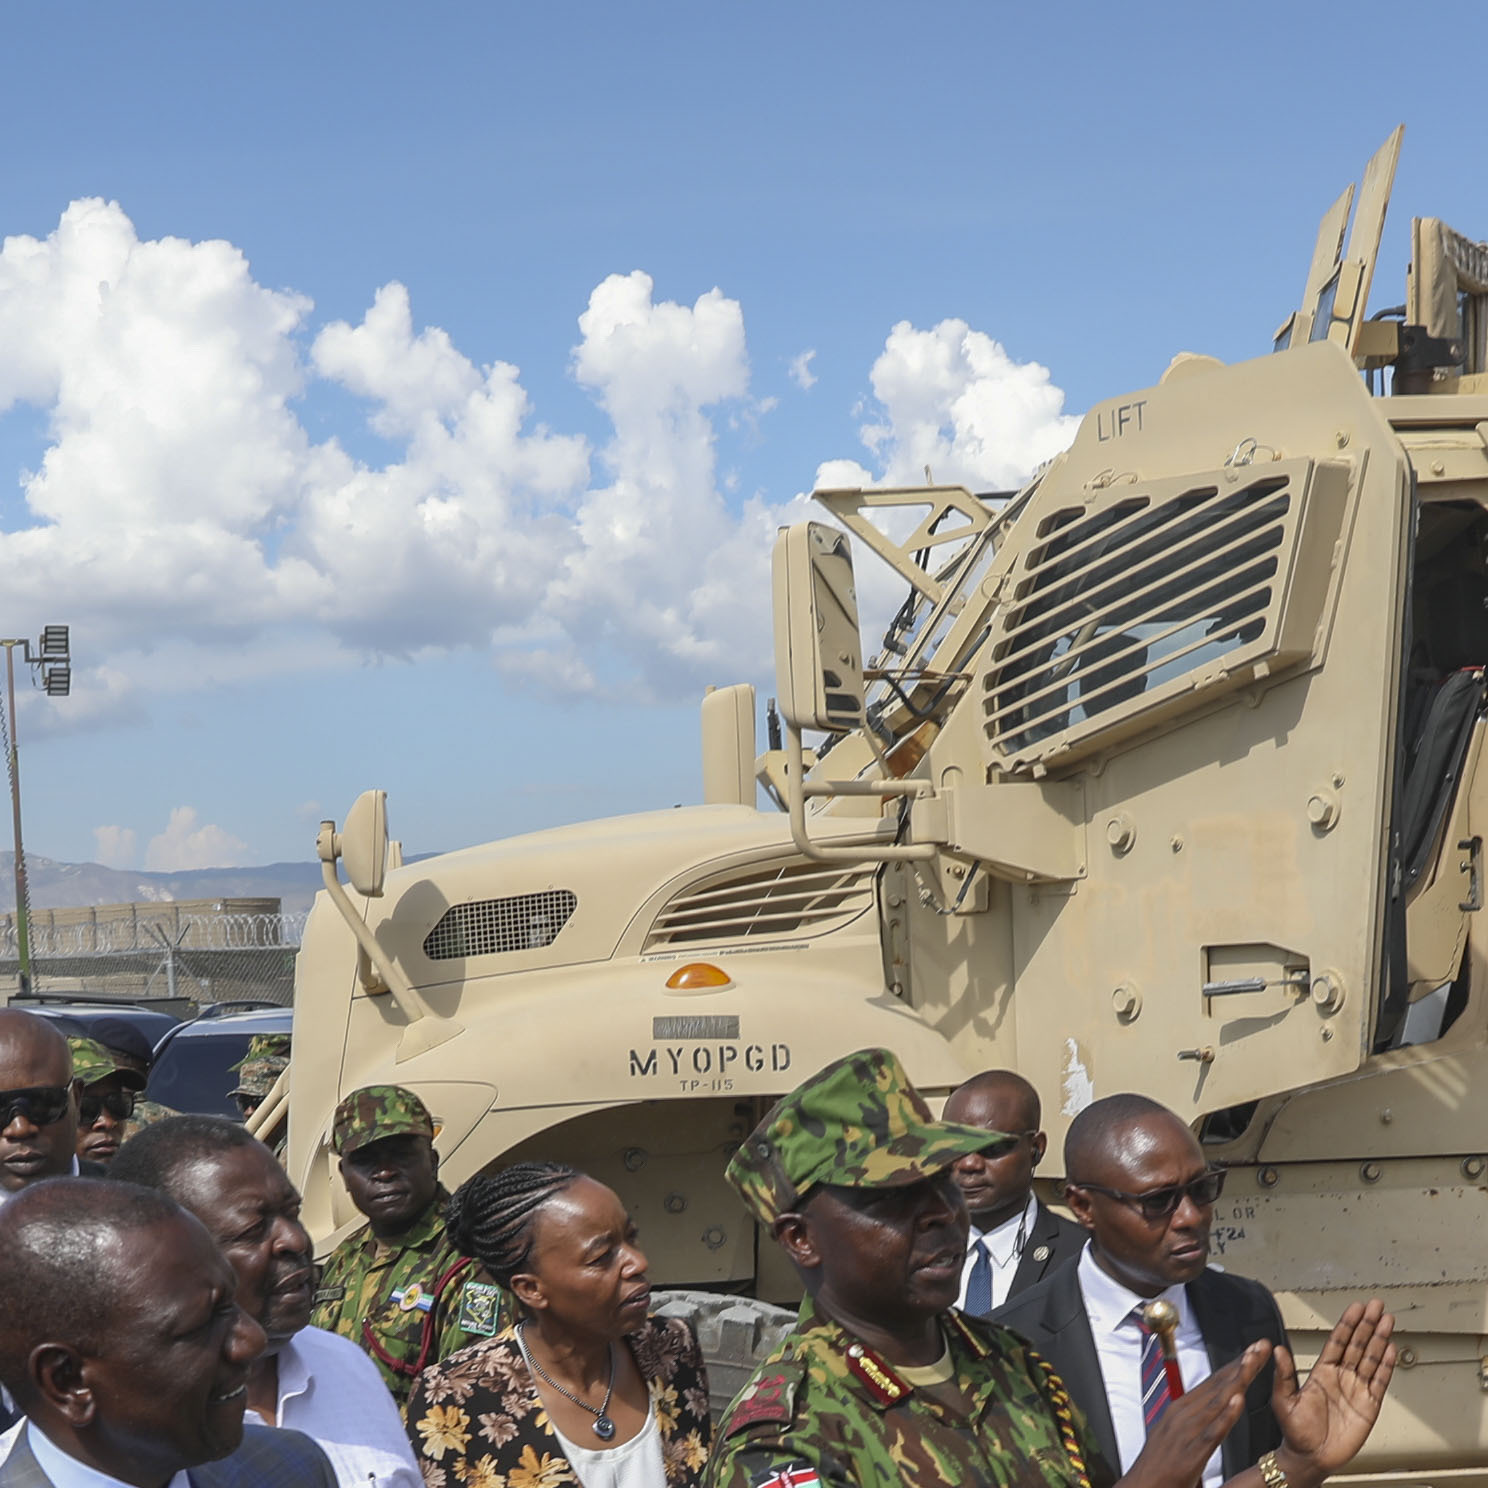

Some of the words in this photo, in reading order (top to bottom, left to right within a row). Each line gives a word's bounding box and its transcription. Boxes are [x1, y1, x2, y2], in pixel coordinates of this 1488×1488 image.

[1097, 400, 1147, 442] LIFT
[680, 1079, 735, 1092] TP-115
[1233, 1207, 1255, 1220] OR
